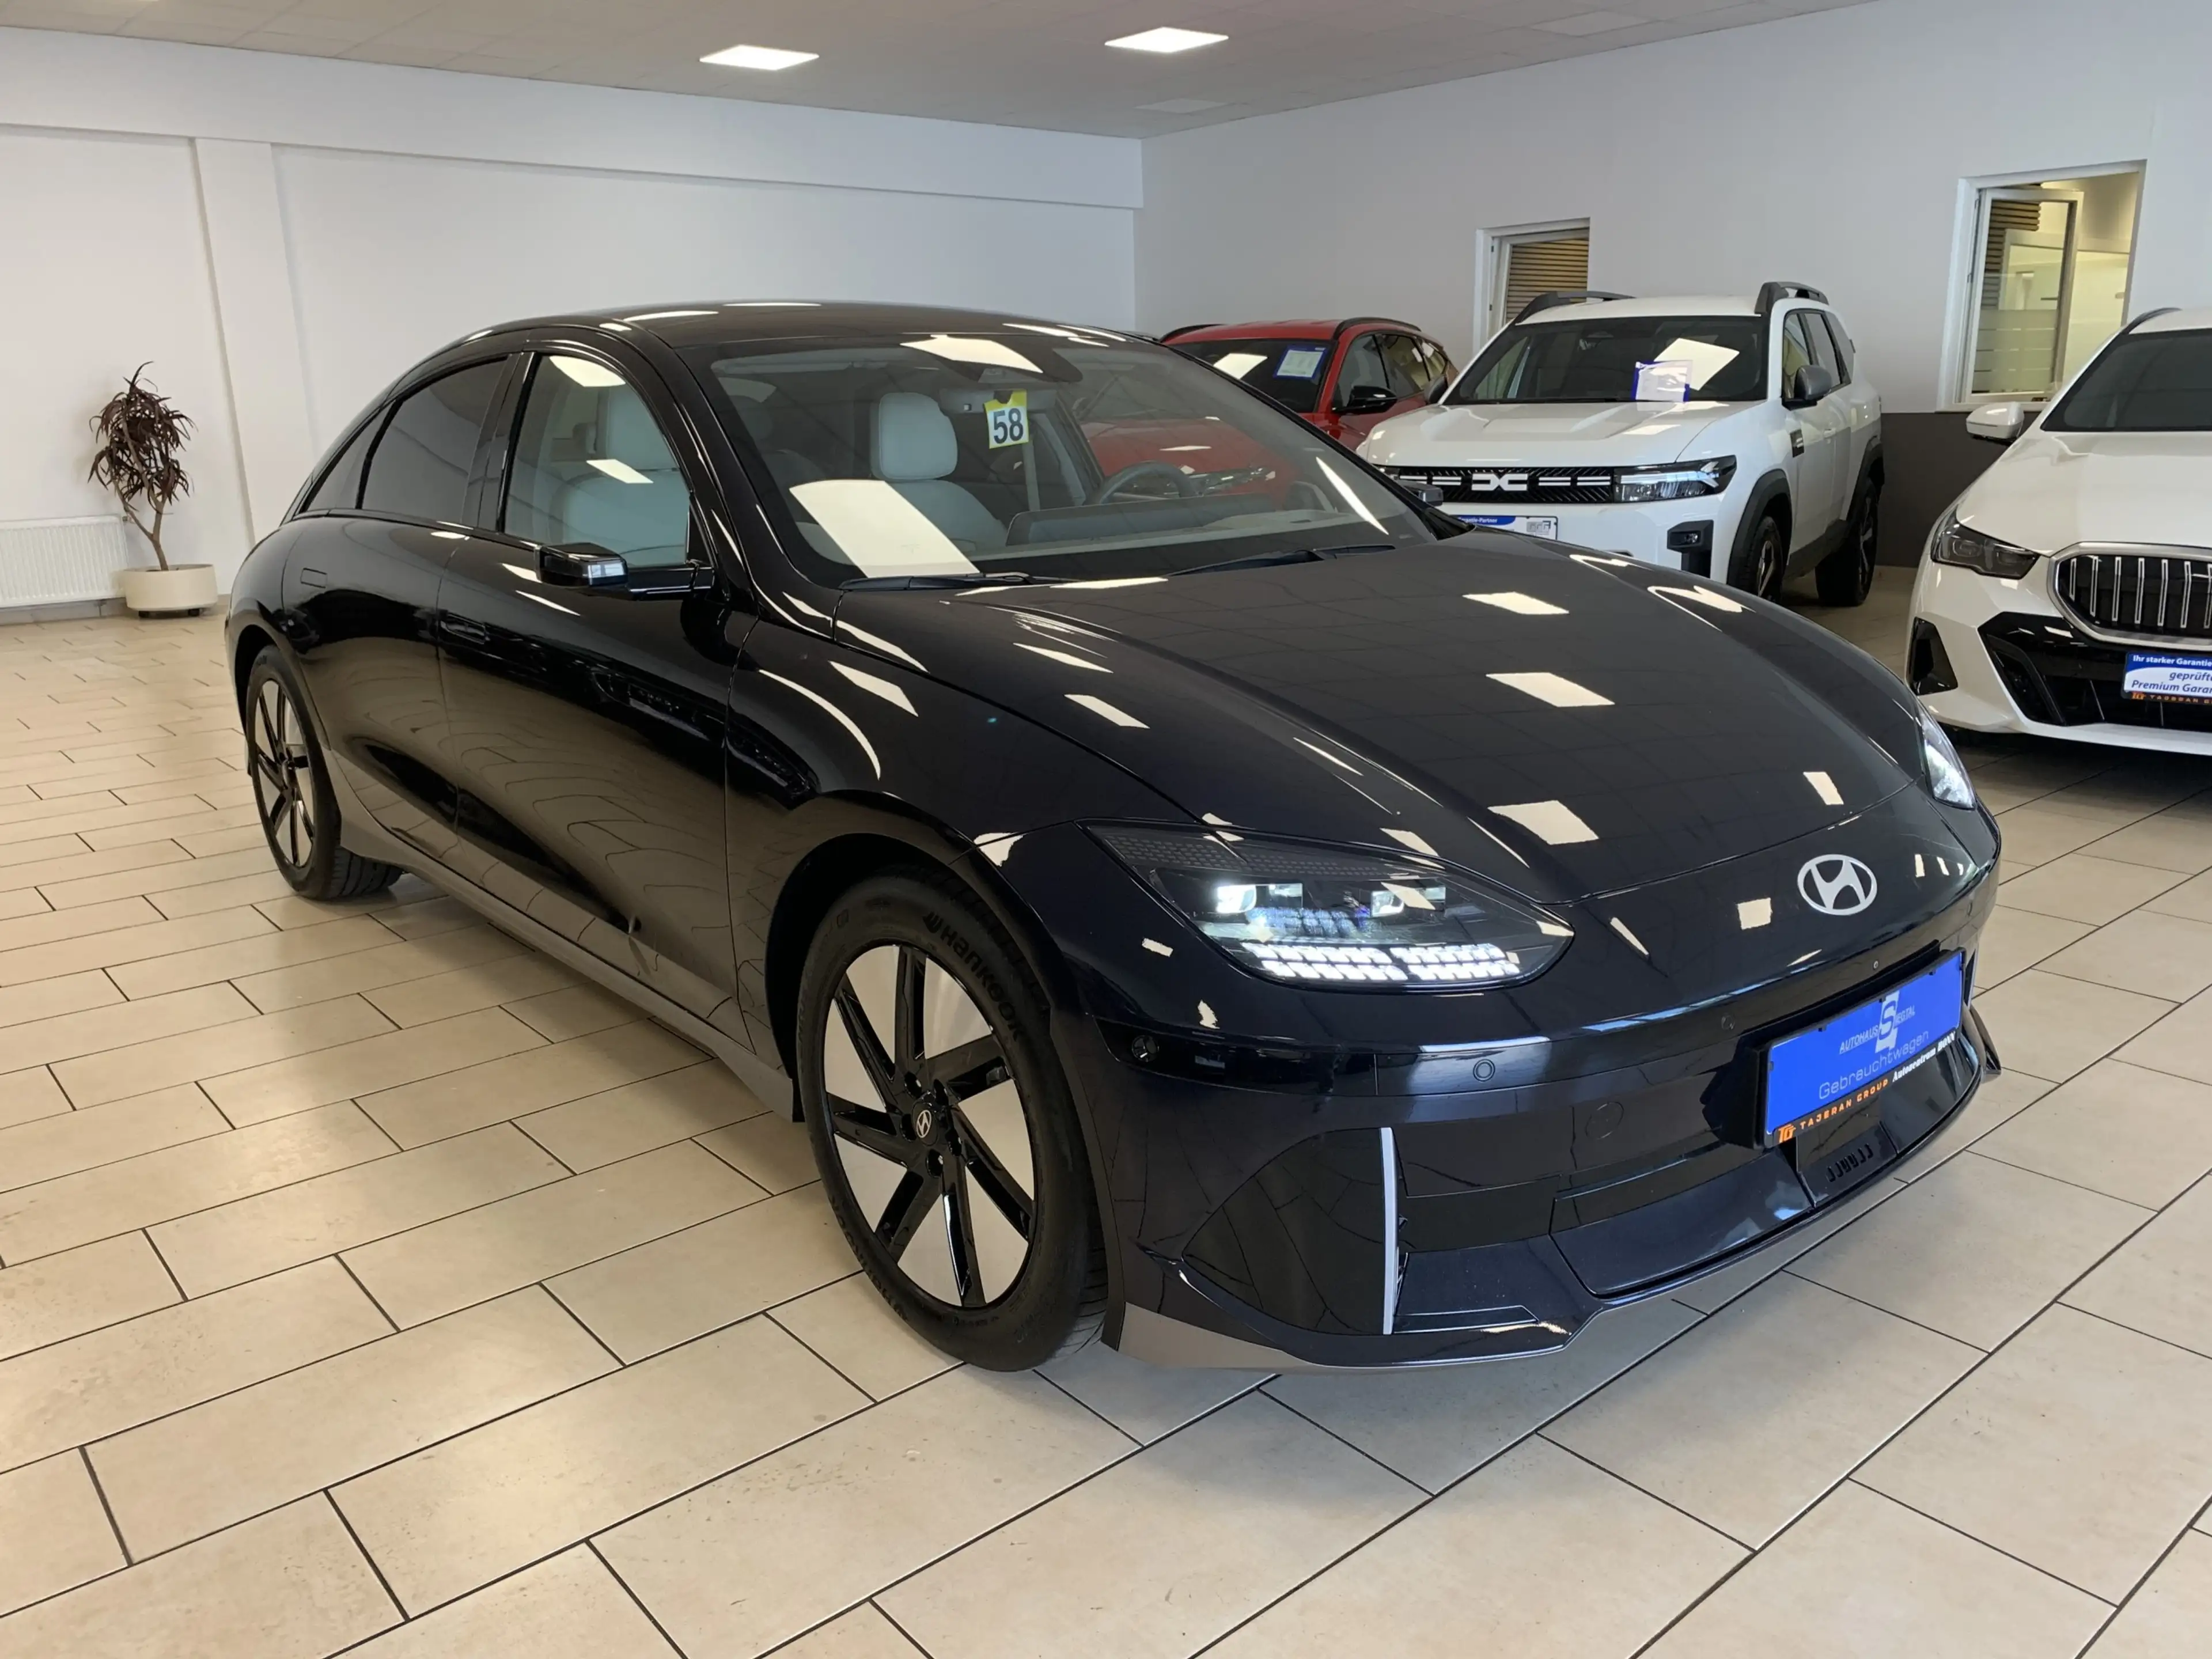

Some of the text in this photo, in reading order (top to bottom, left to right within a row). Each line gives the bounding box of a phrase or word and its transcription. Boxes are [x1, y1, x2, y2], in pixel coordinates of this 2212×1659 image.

[993, 408, 1024, 444] 58
[2131, 680, 2180, 691] Premium
[1839, 1025, 1878, 1055] AUTOHAUS
[1819, 1031, 1929, 1100] Gebrauchtwagen
[1800, 1099, 1852, 1130] TAJERAN
[1857, 1078, 1888, 1103] GROUP
[1892, 1047, 1936, 1083] Autozentrum
